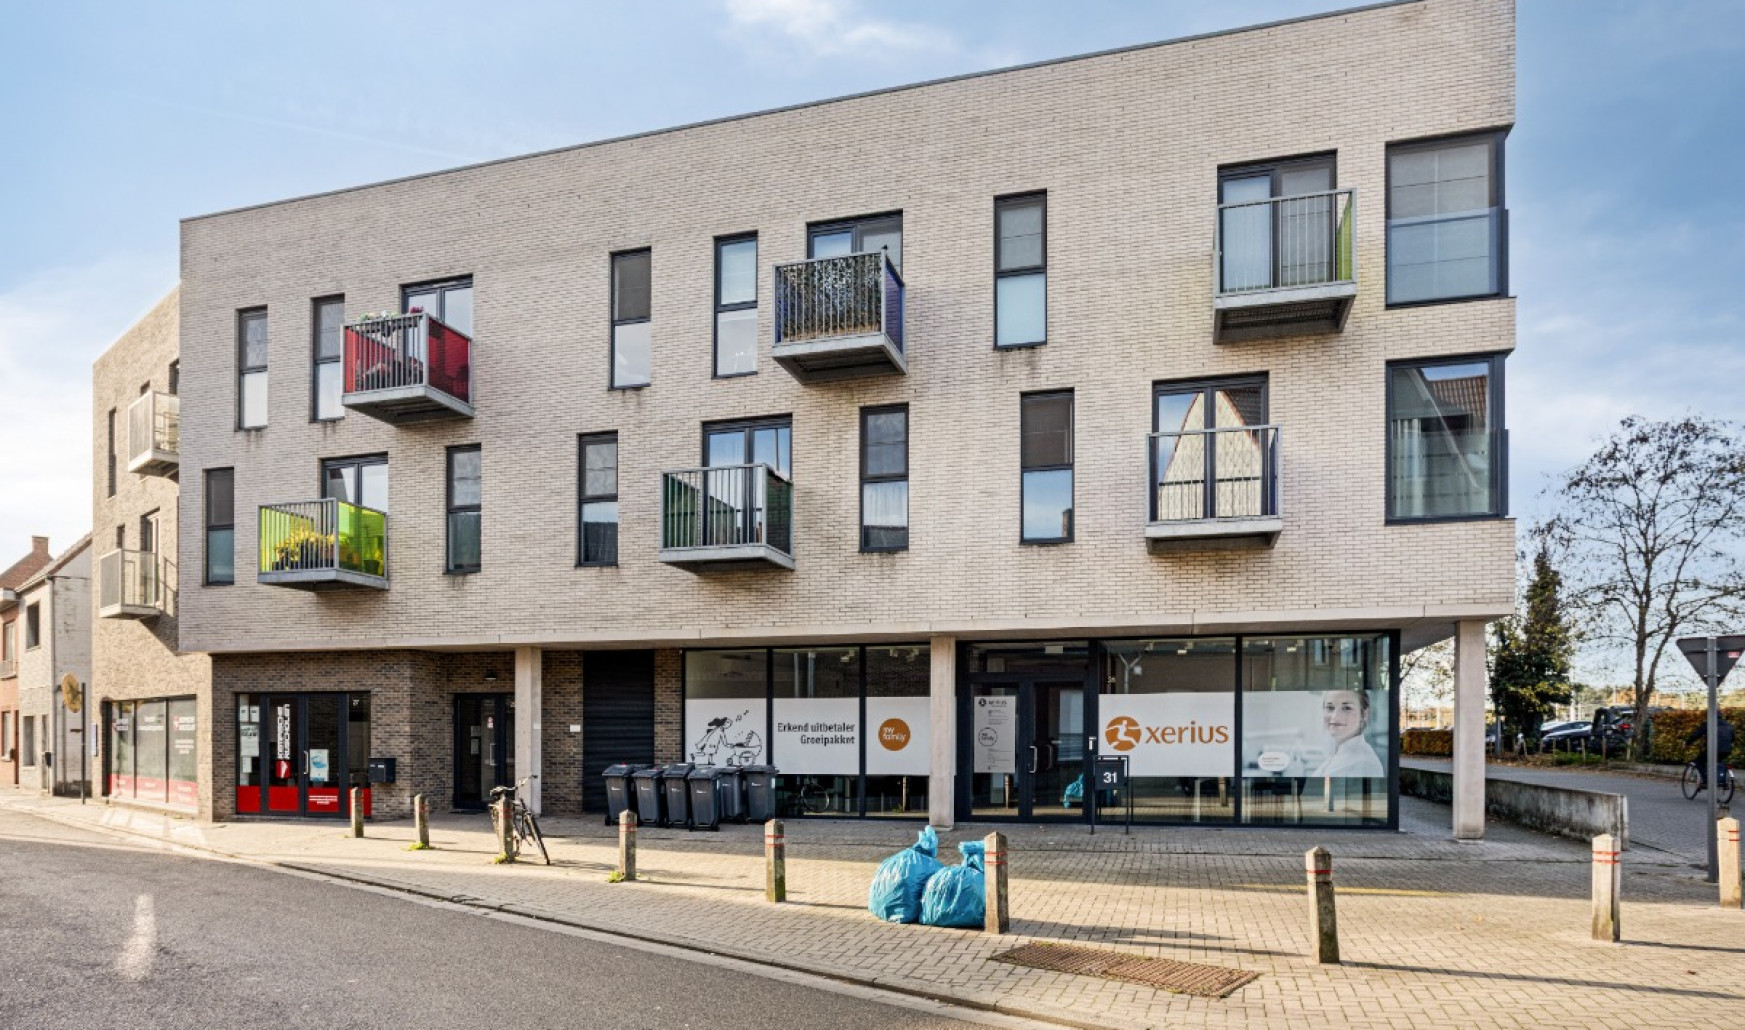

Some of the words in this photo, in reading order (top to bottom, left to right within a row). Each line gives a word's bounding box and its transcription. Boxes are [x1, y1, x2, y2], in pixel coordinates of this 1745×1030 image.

[777, 722, 809, 733] Erkend
[811, 722, 855, 733] uitbetaler
[1144, 720, 1230, 744] xerius
[800, 734, 855, 747] Groeipakket
[1103, 771, 1118, 784] 31
